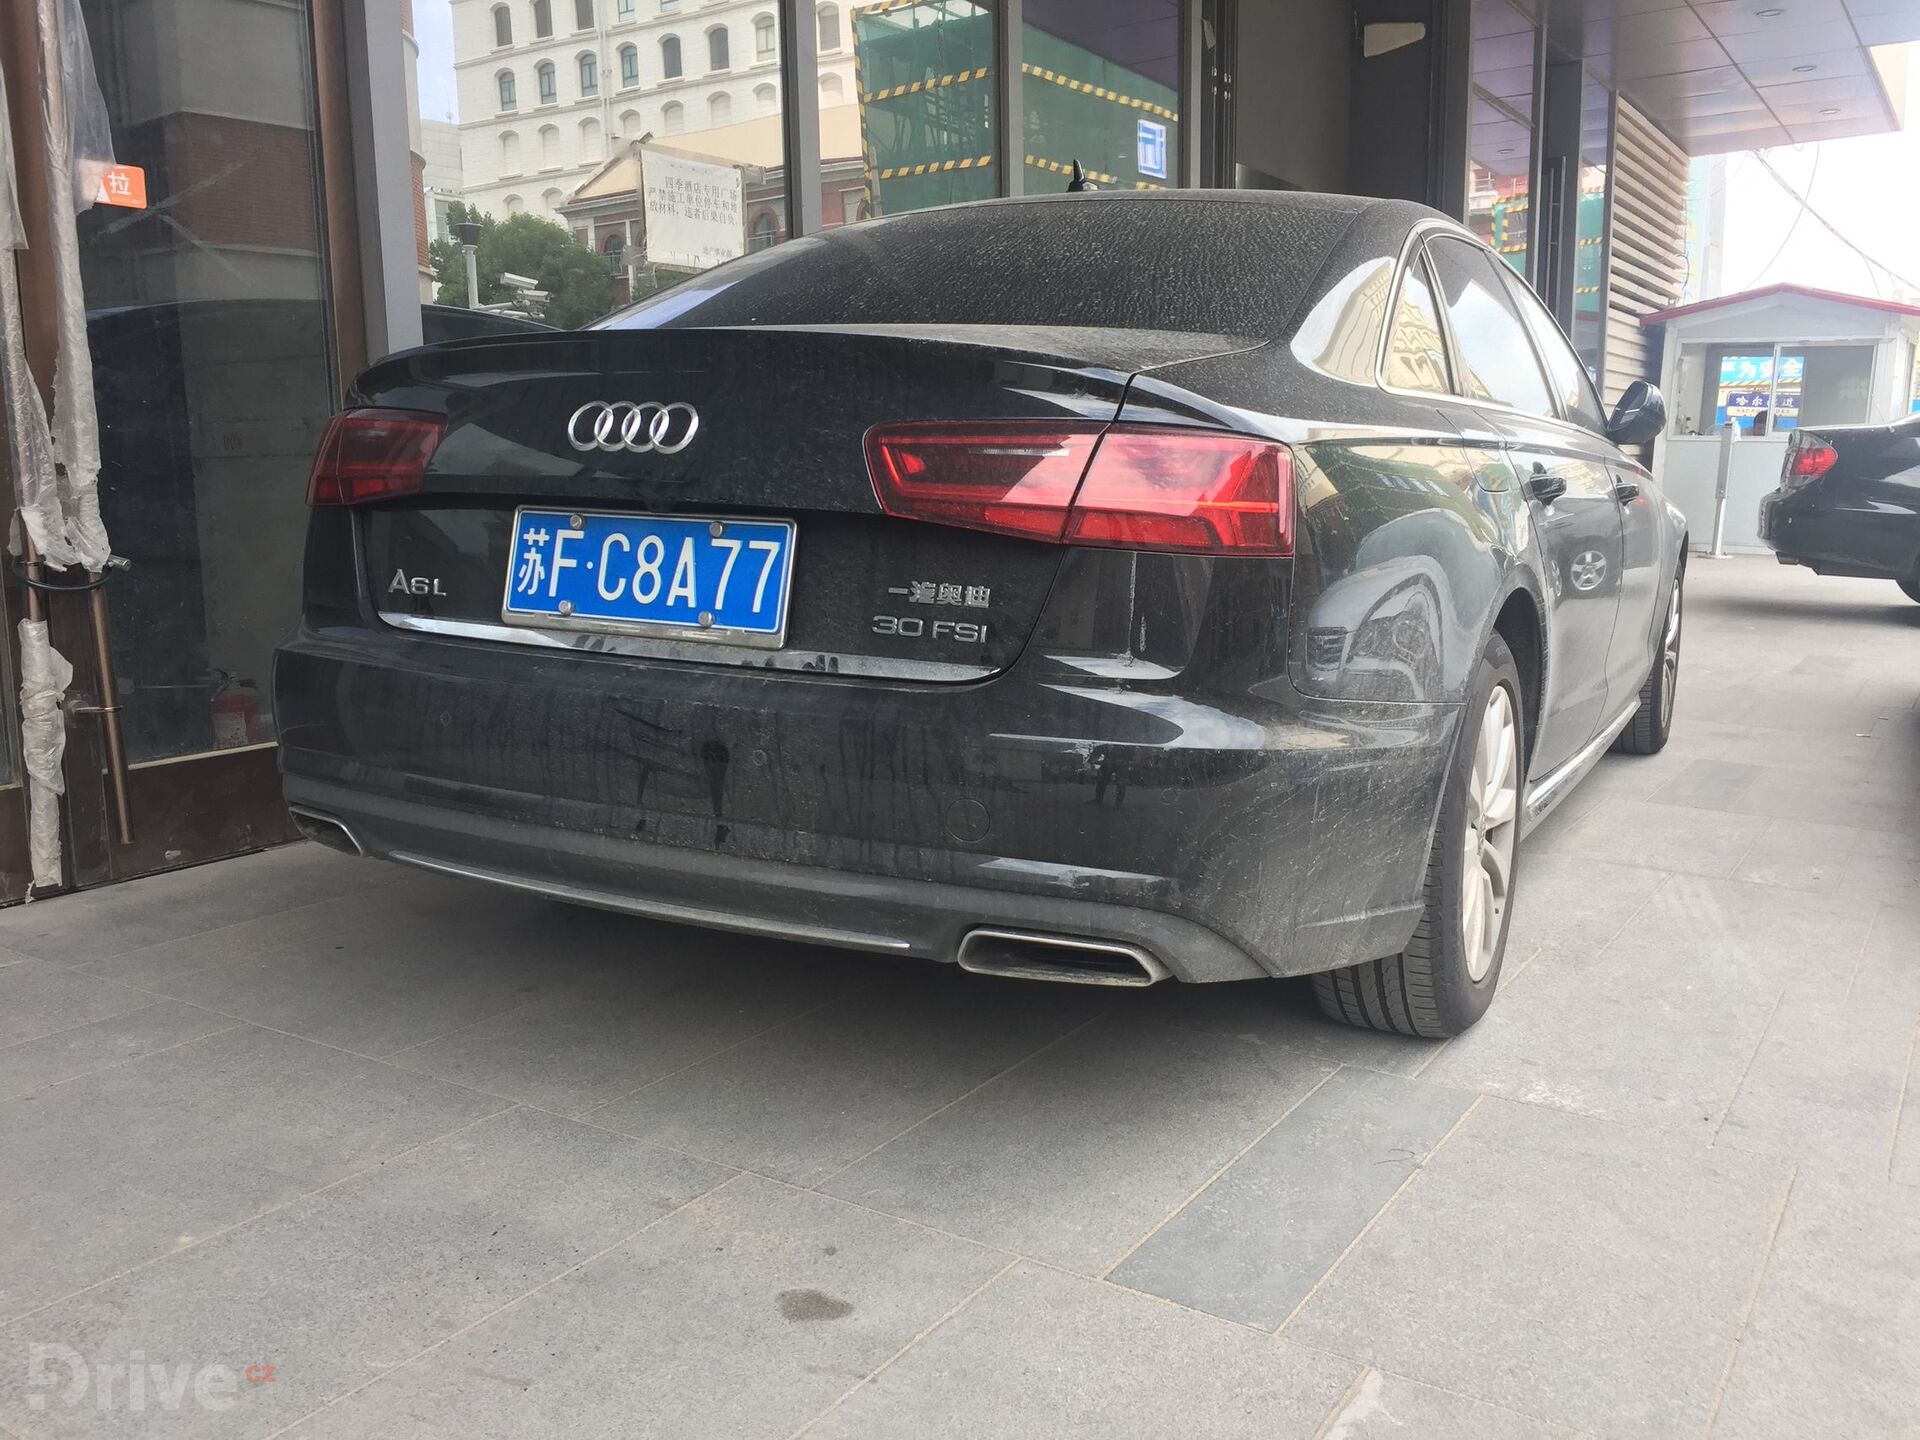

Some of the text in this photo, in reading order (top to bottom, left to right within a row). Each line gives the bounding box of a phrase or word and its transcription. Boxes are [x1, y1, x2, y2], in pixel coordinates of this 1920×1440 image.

[107, 171, 132, 195] 拉
[664, 176, 738, 202] 四季酒店专用广场
[387, 568, 448, 597] A6L
[871, 615, 988, 643] 30 FSI
